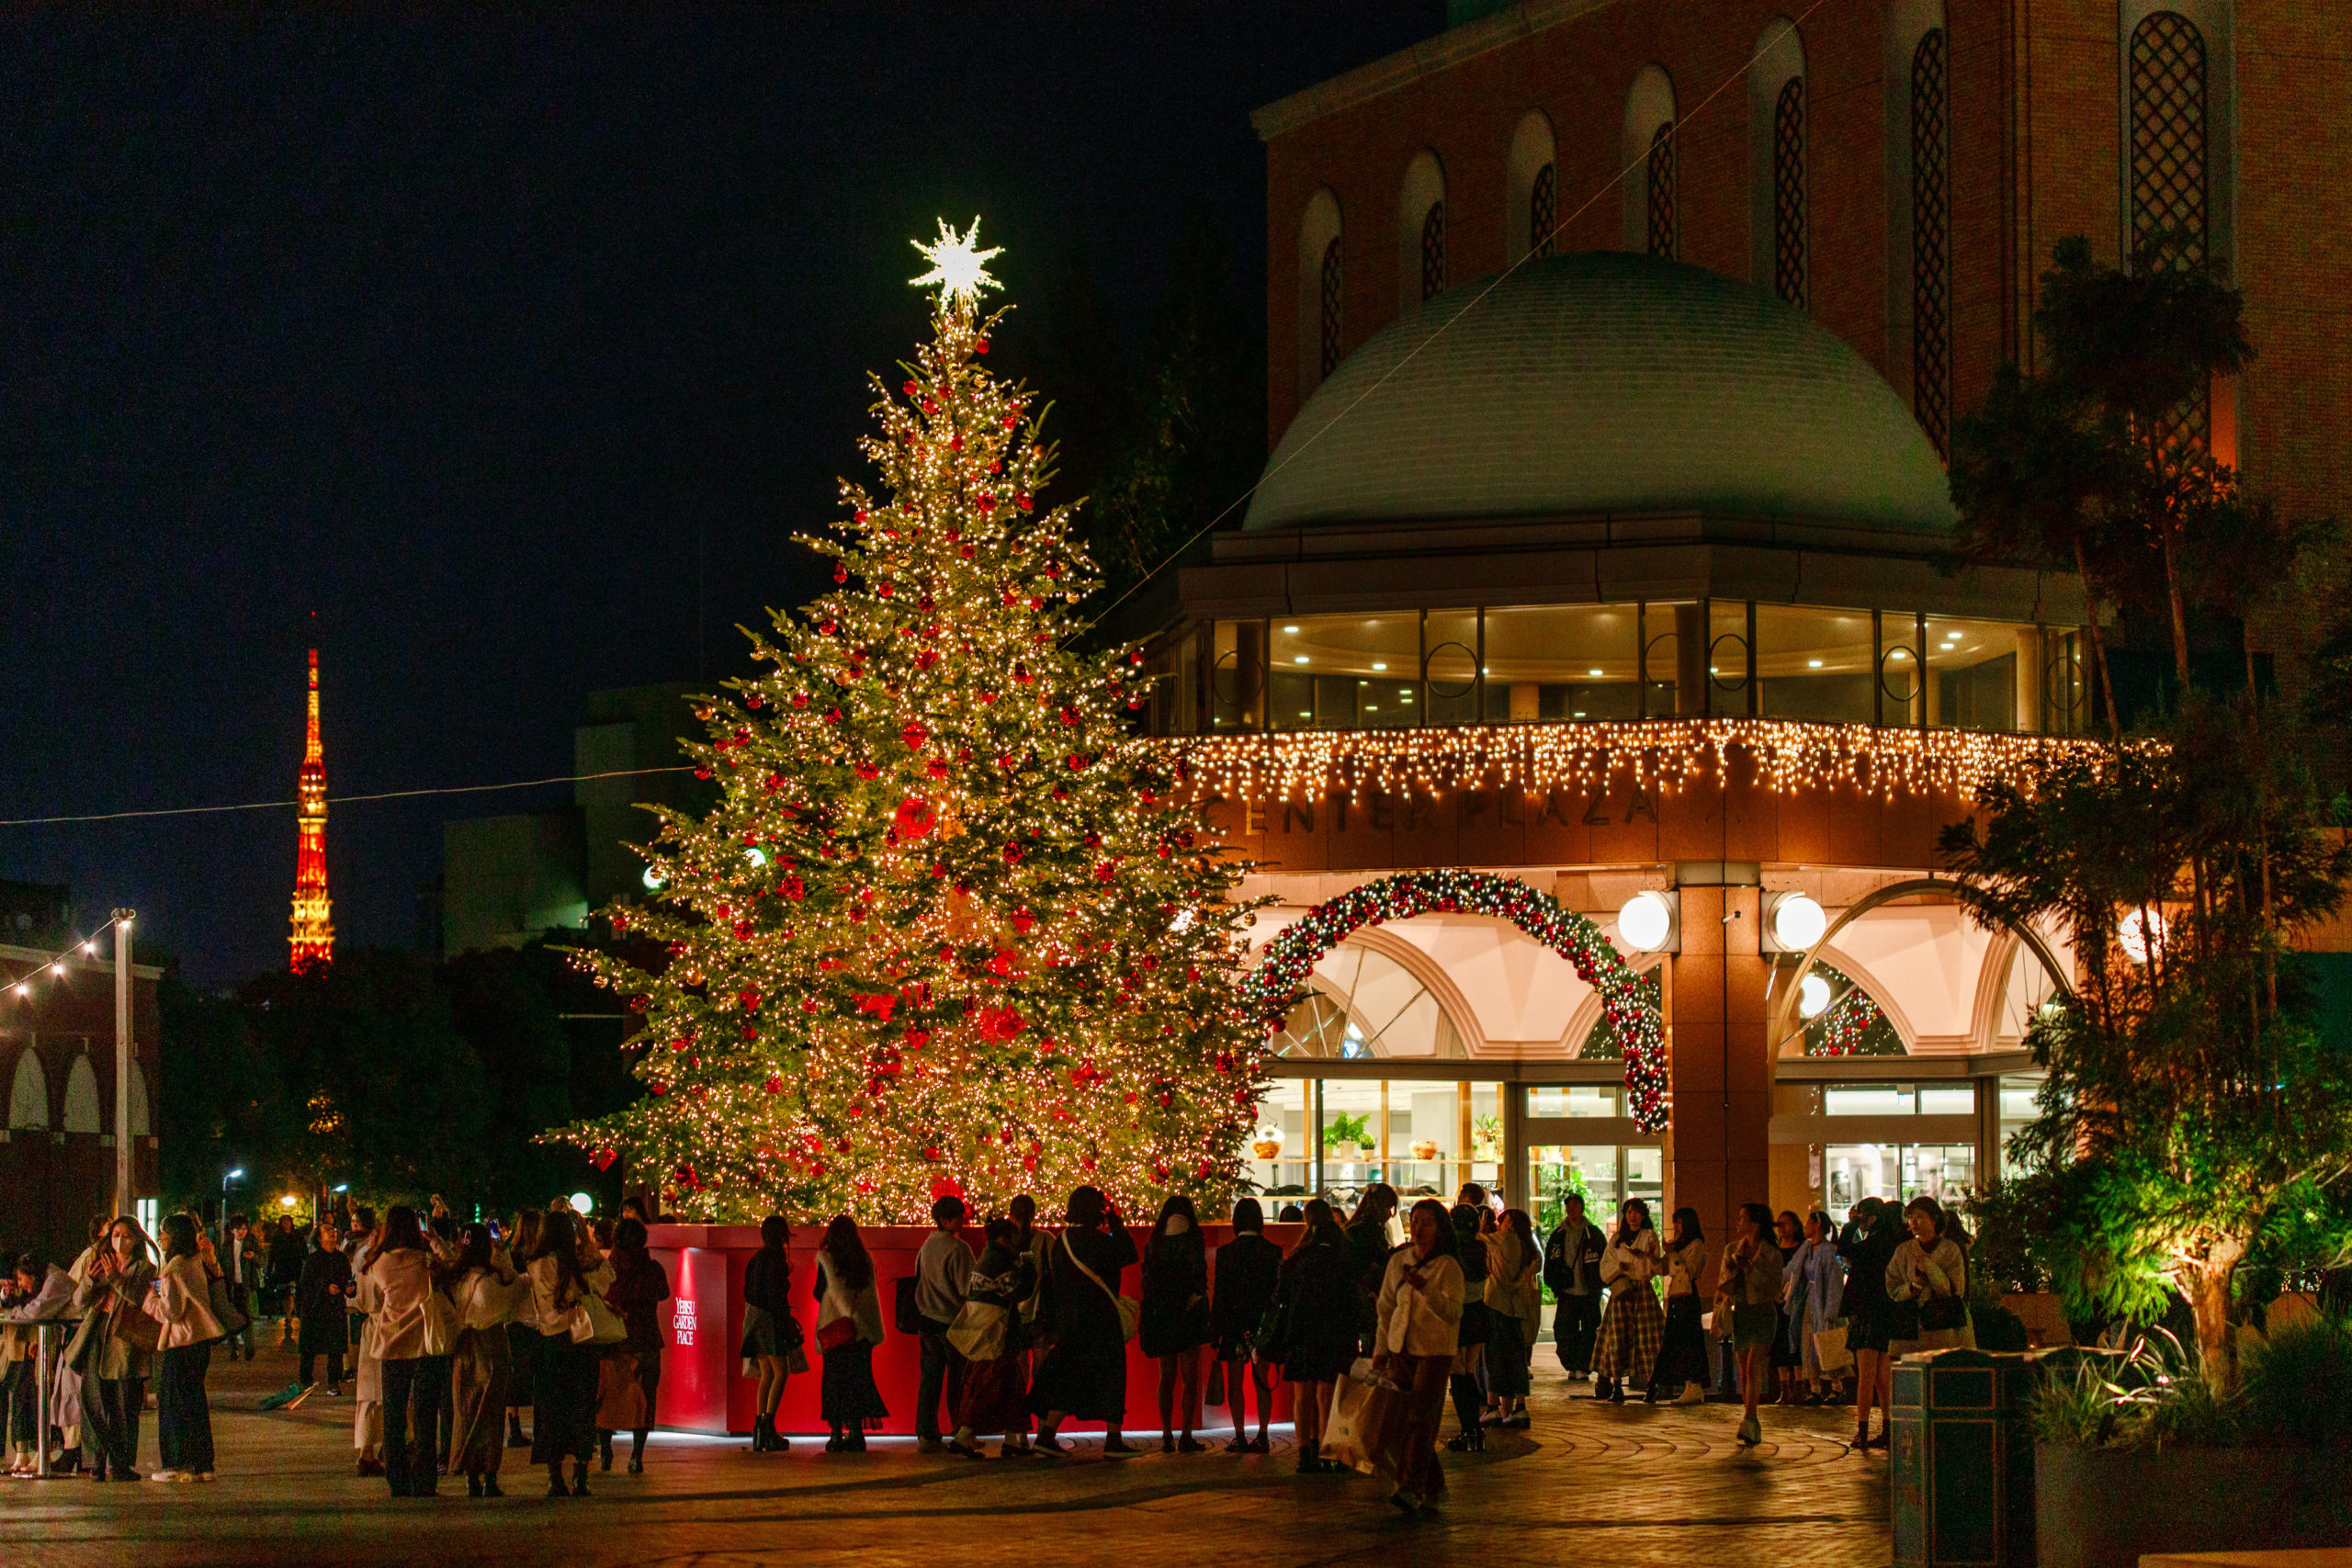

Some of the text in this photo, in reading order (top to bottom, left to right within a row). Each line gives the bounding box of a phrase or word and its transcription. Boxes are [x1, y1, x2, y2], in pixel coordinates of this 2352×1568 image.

[1200, 786, 1657, 836] CENTER PLAZA
[673, 1314, 697, 1331] GARDEN
[676, 1330, 694, 1346] PLACE
